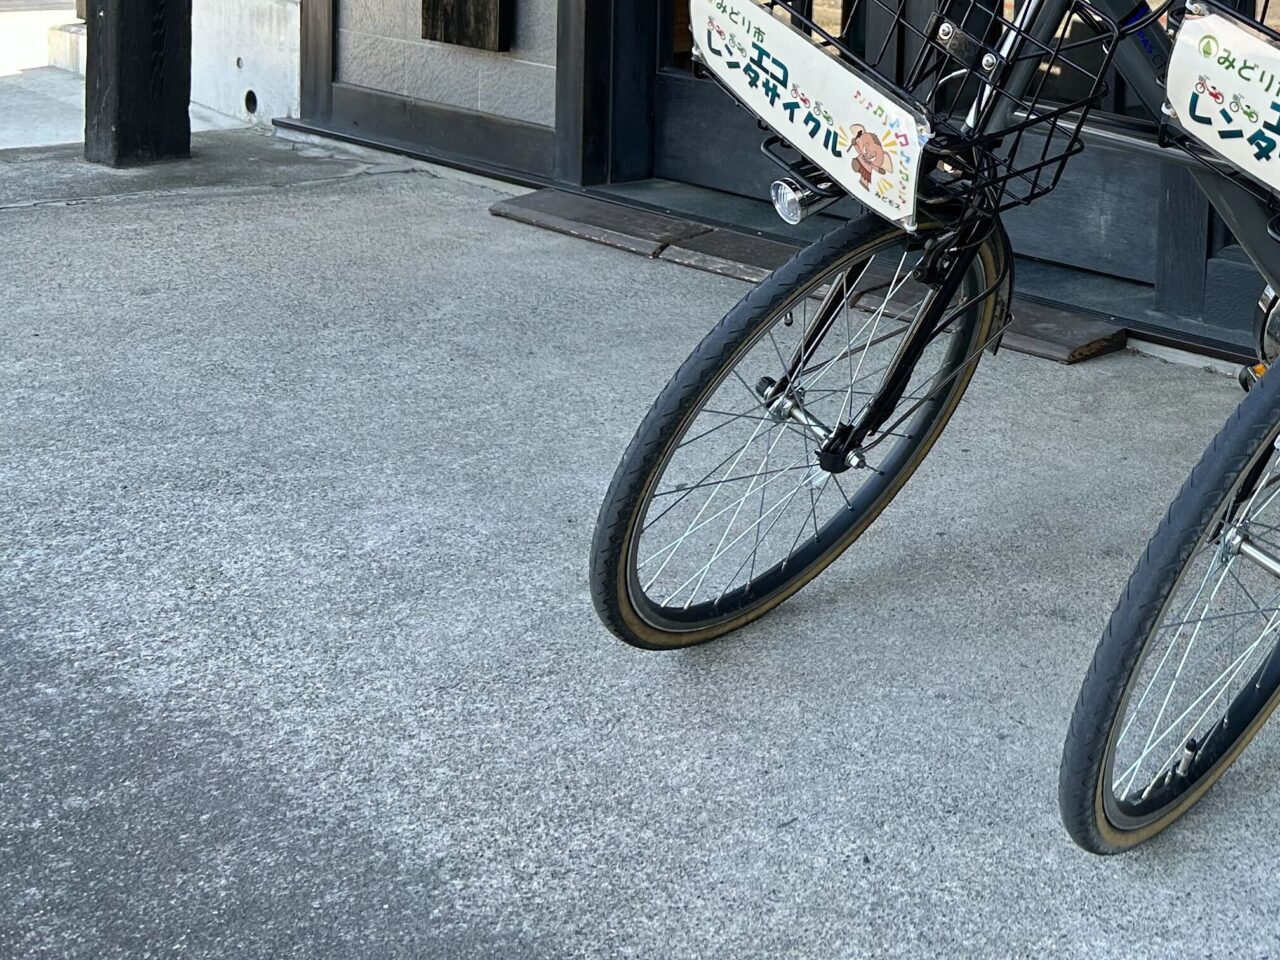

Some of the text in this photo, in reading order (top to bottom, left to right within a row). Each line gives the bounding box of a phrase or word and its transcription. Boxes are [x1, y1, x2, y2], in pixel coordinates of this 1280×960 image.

[749, 41, 789, 89] エコ
[707, 28, 842, 158] レンタサイクル
[874, 191, 901, 210] みどモス
